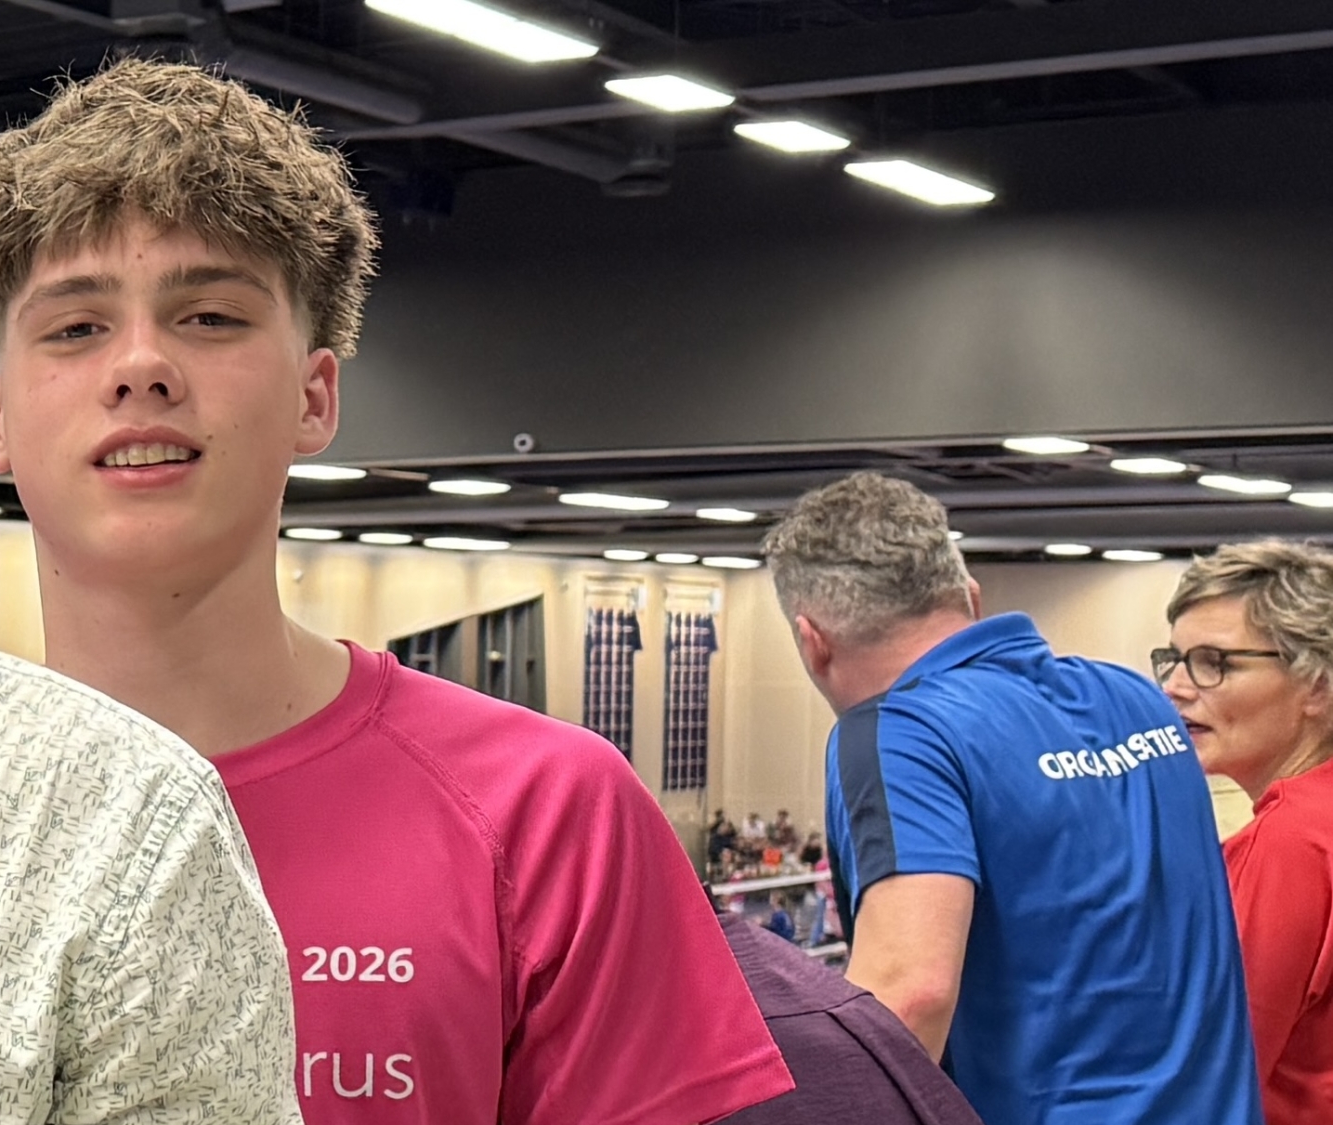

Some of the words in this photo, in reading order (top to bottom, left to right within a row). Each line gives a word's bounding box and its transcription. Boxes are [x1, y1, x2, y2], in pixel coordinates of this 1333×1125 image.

[1037, 724, 1188, 780] ORGANISATIE
[300, 945, 415, 983] 2026
[302, 1051, 415, 1100] rus
